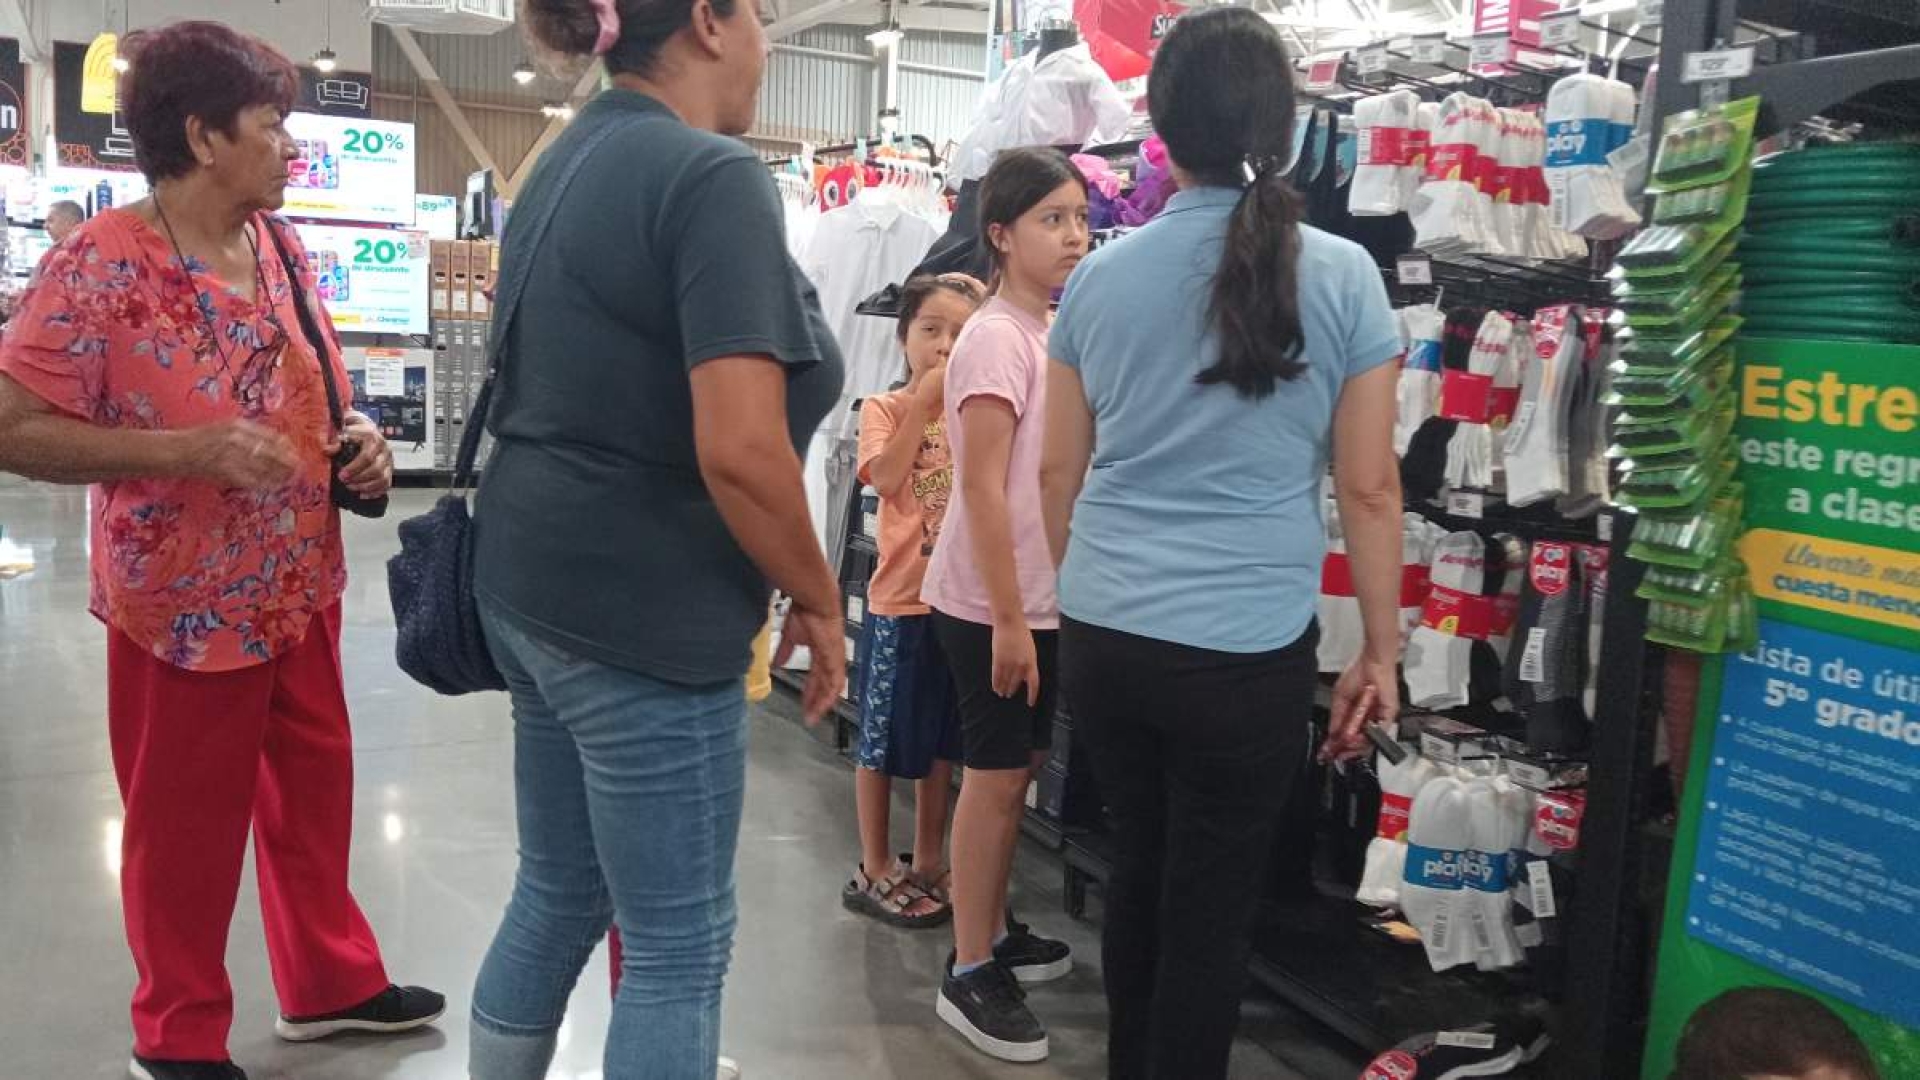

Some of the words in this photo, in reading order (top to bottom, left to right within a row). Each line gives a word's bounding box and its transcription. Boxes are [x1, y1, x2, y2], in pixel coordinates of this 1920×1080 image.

[343, 128, 404, 154] 20%
[1743, 365, 1919, 432] Estre
[1741, 437, 1824, 471] este
[1834, 449, 1920, 489] regr
[1786, 487, 1811, 514] a
[1821, 487, 1920, 532] clase
[1773, 573, 1850, 604] cuesta
[1820, 657, 1864, 689] de
[1815, 697, 1920, 746] grado
